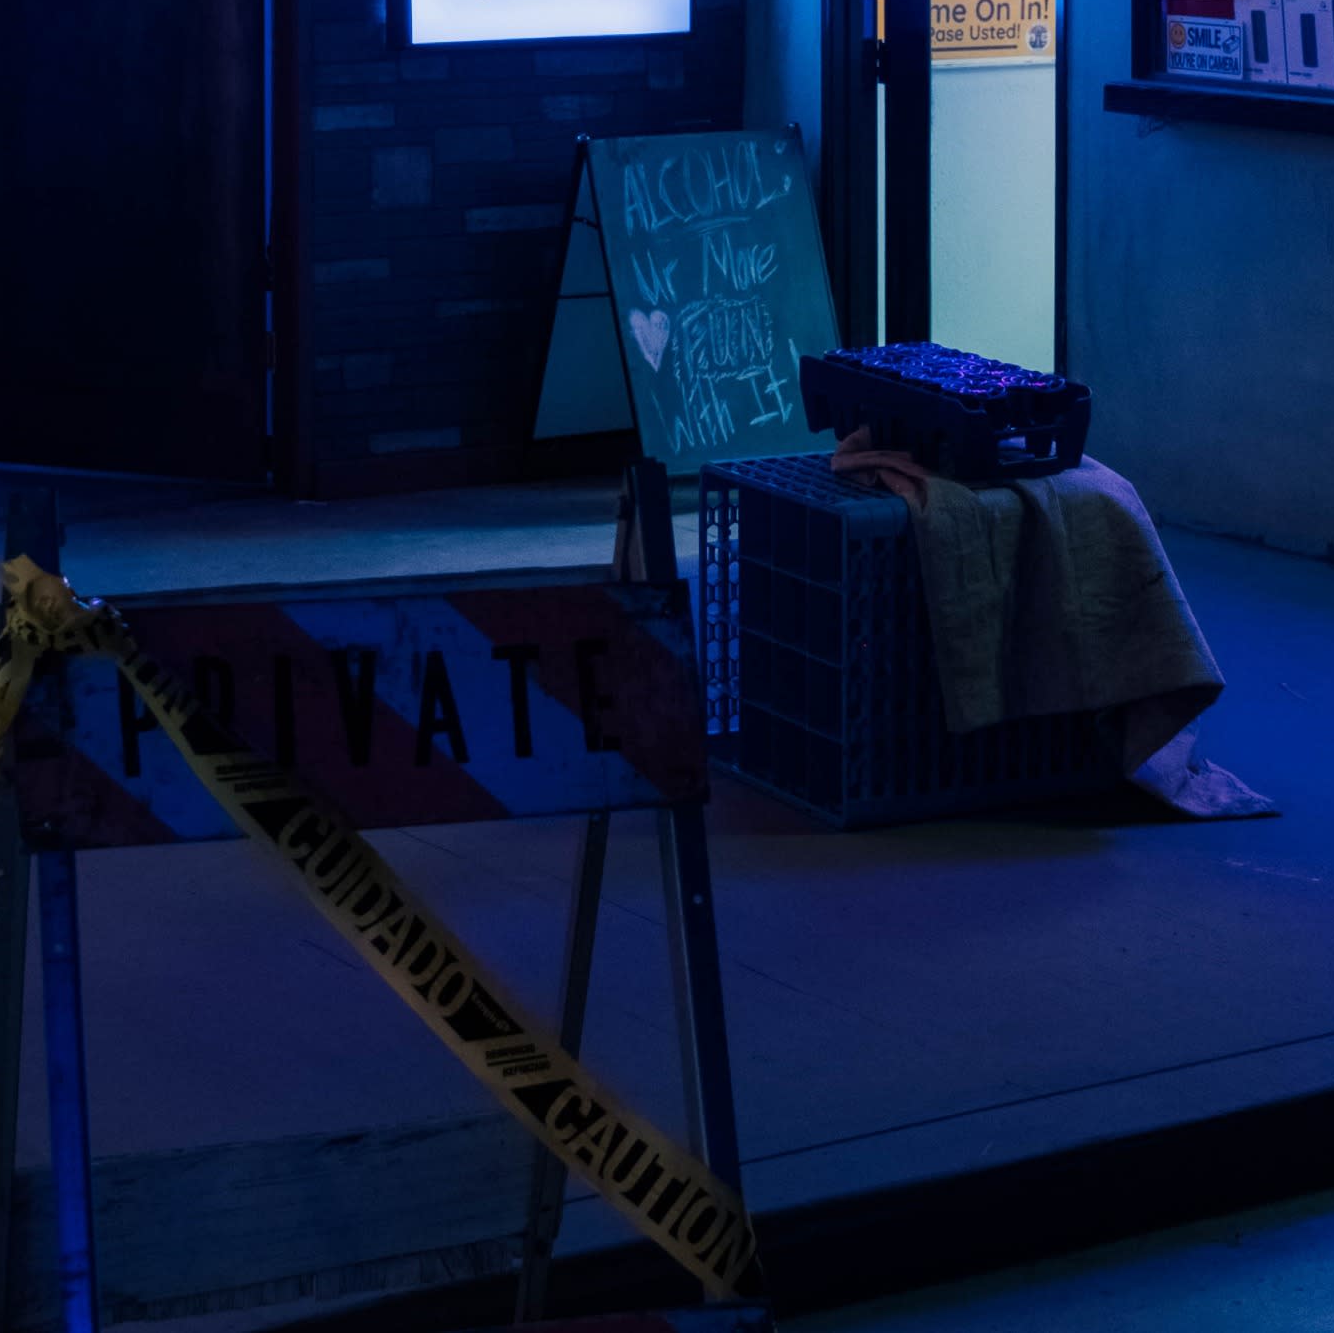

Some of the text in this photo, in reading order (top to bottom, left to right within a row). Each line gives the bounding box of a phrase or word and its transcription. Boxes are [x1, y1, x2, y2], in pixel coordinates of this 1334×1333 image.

[969, 23, 1021, 41] Usted!
[1187, 27, 1222, 50] SMILE
[1198, 54, 1208, 68] ON
[117, 640, 621, 777] PRIVATE
[277, 804, 473, 1017] CUIDADO
[546, 1087, 756, 1287] CAUTION
